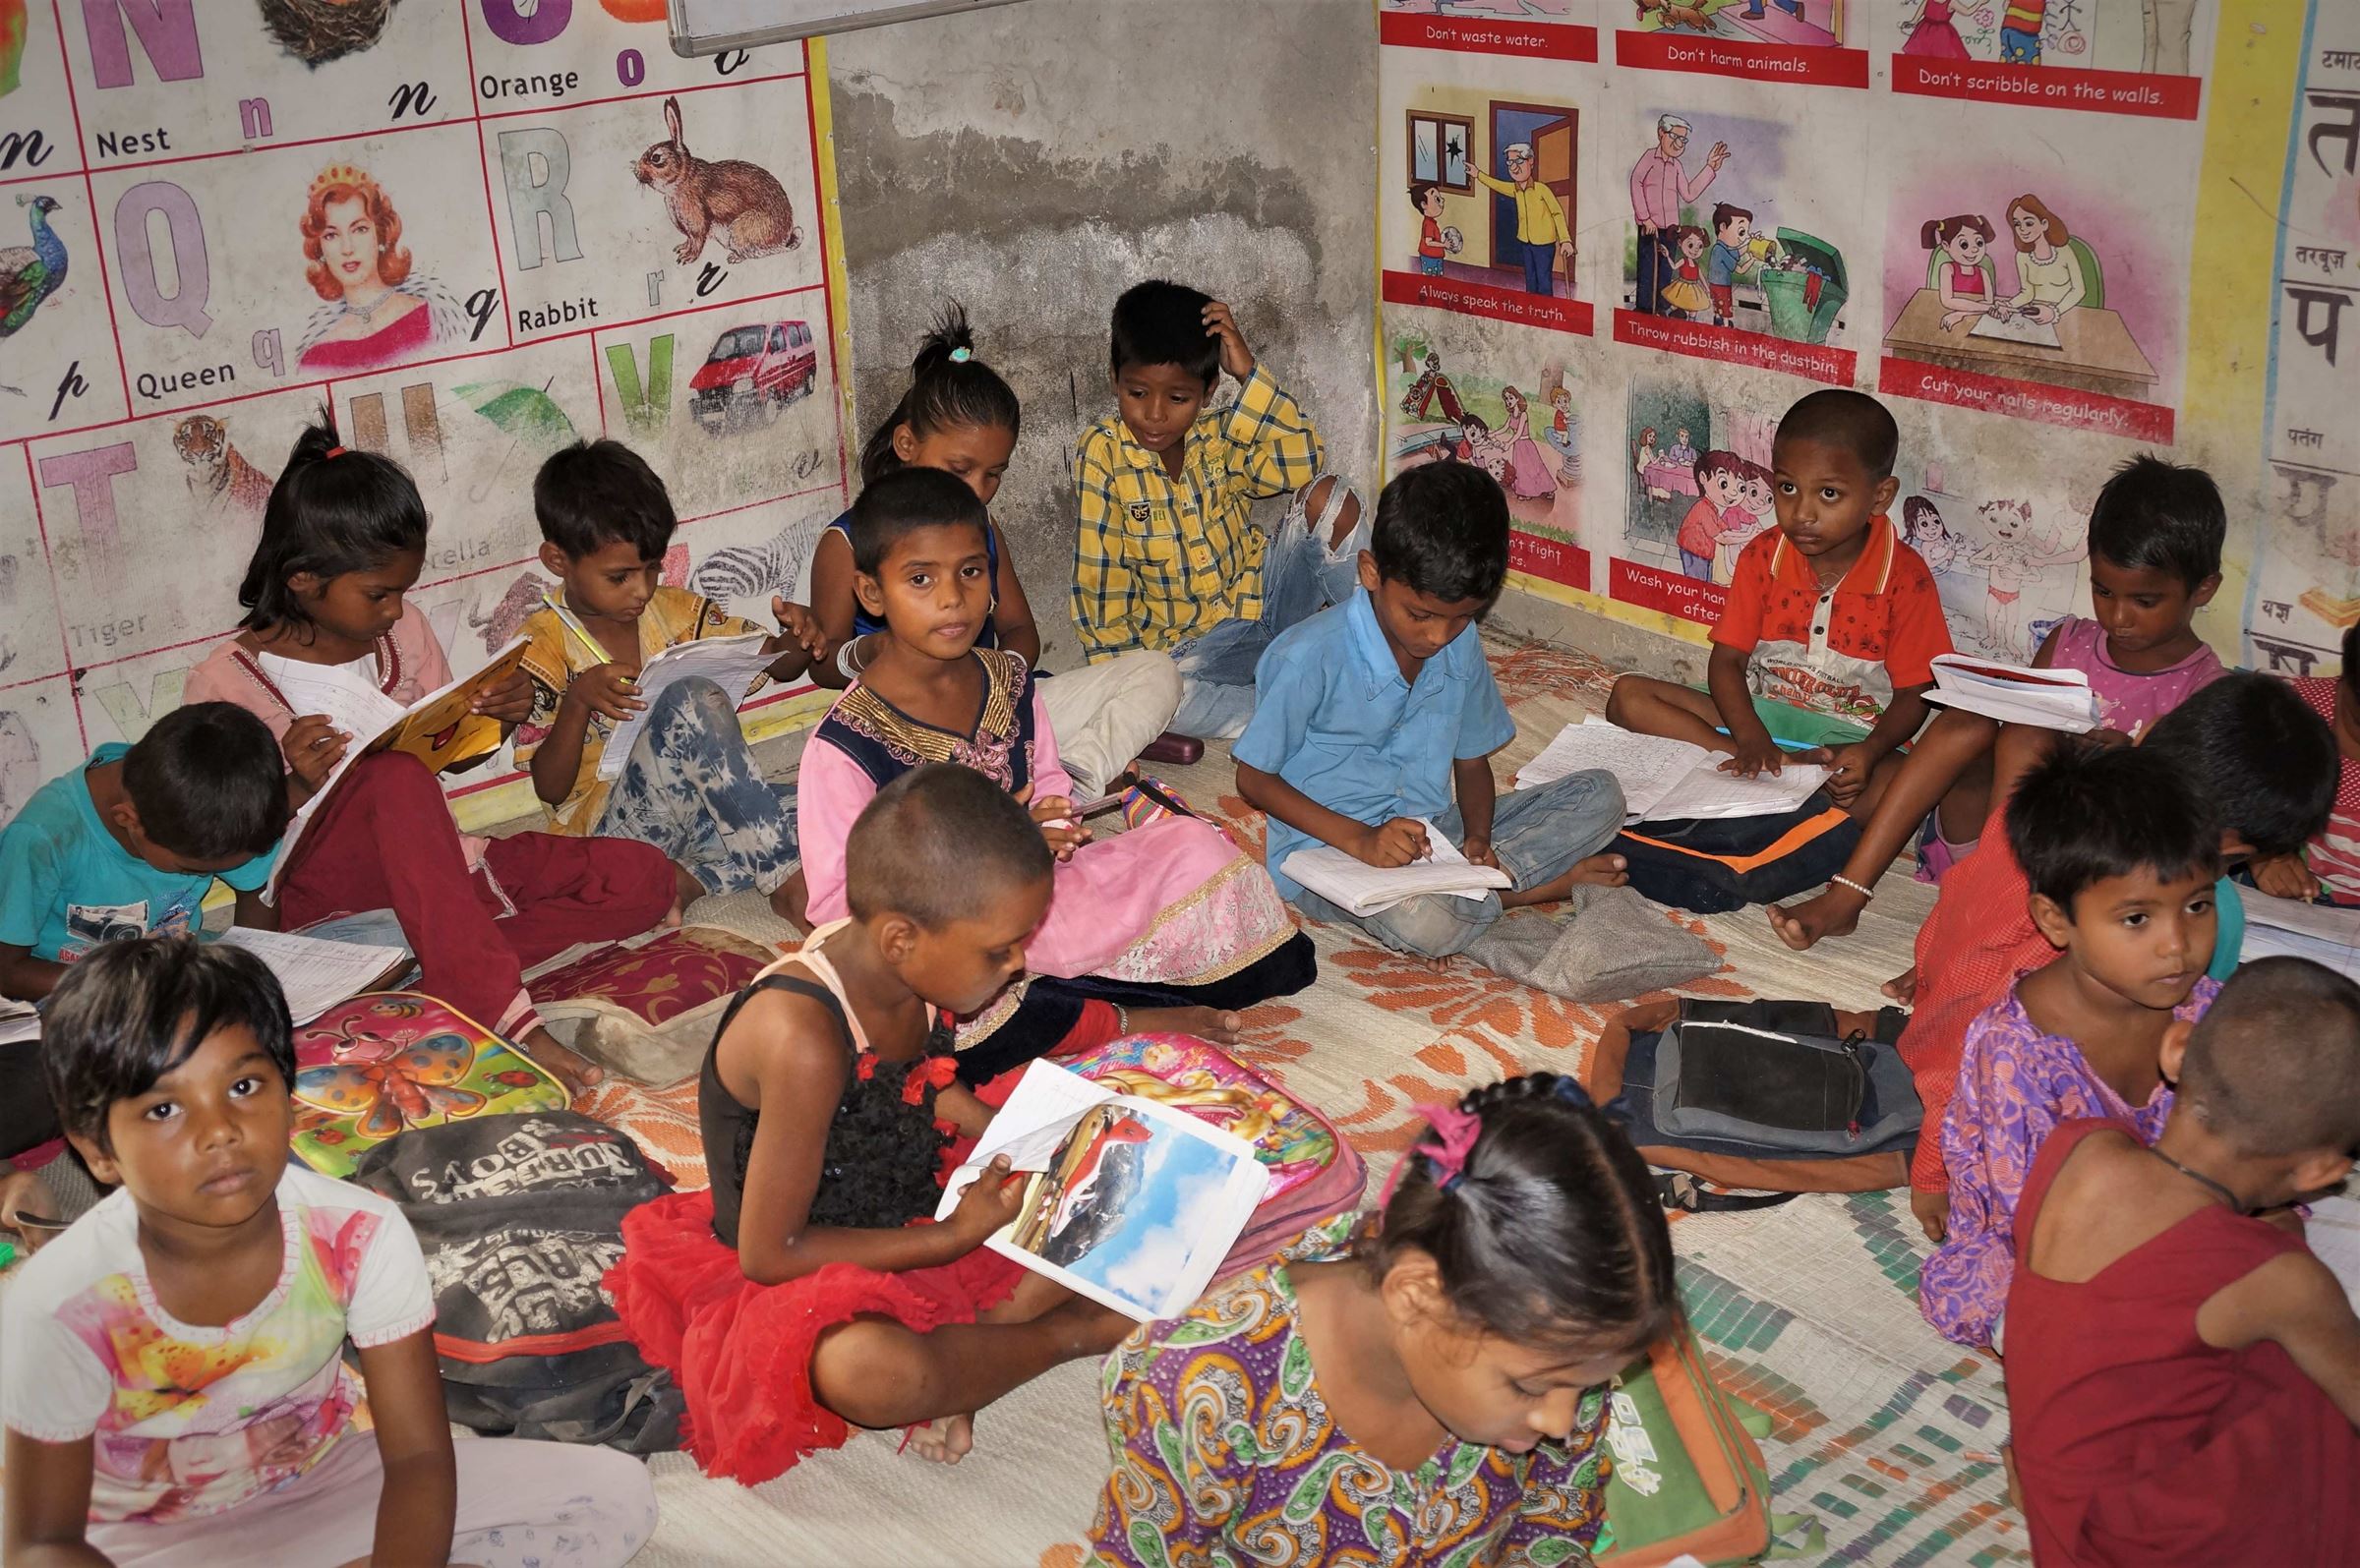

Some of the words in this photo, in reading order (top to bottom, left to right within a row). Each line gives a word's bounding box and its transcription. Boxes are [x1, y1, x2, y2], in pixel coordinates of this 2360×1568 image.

[1426, 25, 1457, 40] Don't
[1461, 31, 1502, 44] waste
[1505, 34, 1549, 48] water.
[1668, 45, 1706, 62] Don't
[1710, 48, 1743, 67] harm
[1747, 56, 1810, 73] animals.
[388, 82, 438, 120] n
[480, 70, 579, 99] Orange
[1918, 69, 1962, 87] Don't
[1967, 75, 2040, 94] scribble
[2045, 84, 2067, 97] on
[2073, 82, 2105, 100] the
[2112, 86, 2164, 105] walls.
[239, 97, 273, 140] n
[97, 128, 171, 158] Nest
[499, 127, 584, 271] R
[114, 181, 213, 340] Q
[646, 268, 665, 307] r
[1419, 285, 1459, 307] Always
[1463, 295, 1499, 311] speak
[1502, 300, 1523, 315] the
[1528, 305, 1566, 322] truth.
[519, 298, 599, 332] Rabbit
[2284, 287, 2354, 369] प
[252, 327, 285, 377] q
[1628, 320, 1669, 341] Throw
[1673, 331, 1730, 352] rubbish
[1735, 339, 1747, 355] in
[1751, 344, 1777, 361] the
[1781, 350, 1839, 375] dustbin.
[137, 363, 235, 399] Queen
[605, 333, 675, 439] V
[1920, 376, 1950, 393] Cut
[1953, 382, 1992, 401] your
[1997, 391, 2036, 410] nails
[2041, 399, 2129, 429] regularly.
[2287, 428, 2325, 449] पतंग
[39, 441, 138, 596] T
[431, 537, 492, 569] rella
[1508, 538, 1524, 551] n't
[1529, 541, 1562, 566] fight
[1625, 567, 1662, 589] Wash
[1666, 582, 1698, 596] your
[1702, 588, 1726, 606] han
[69, 613, 148, 647] Tiger
[1683, 604, 1721, 621] after
